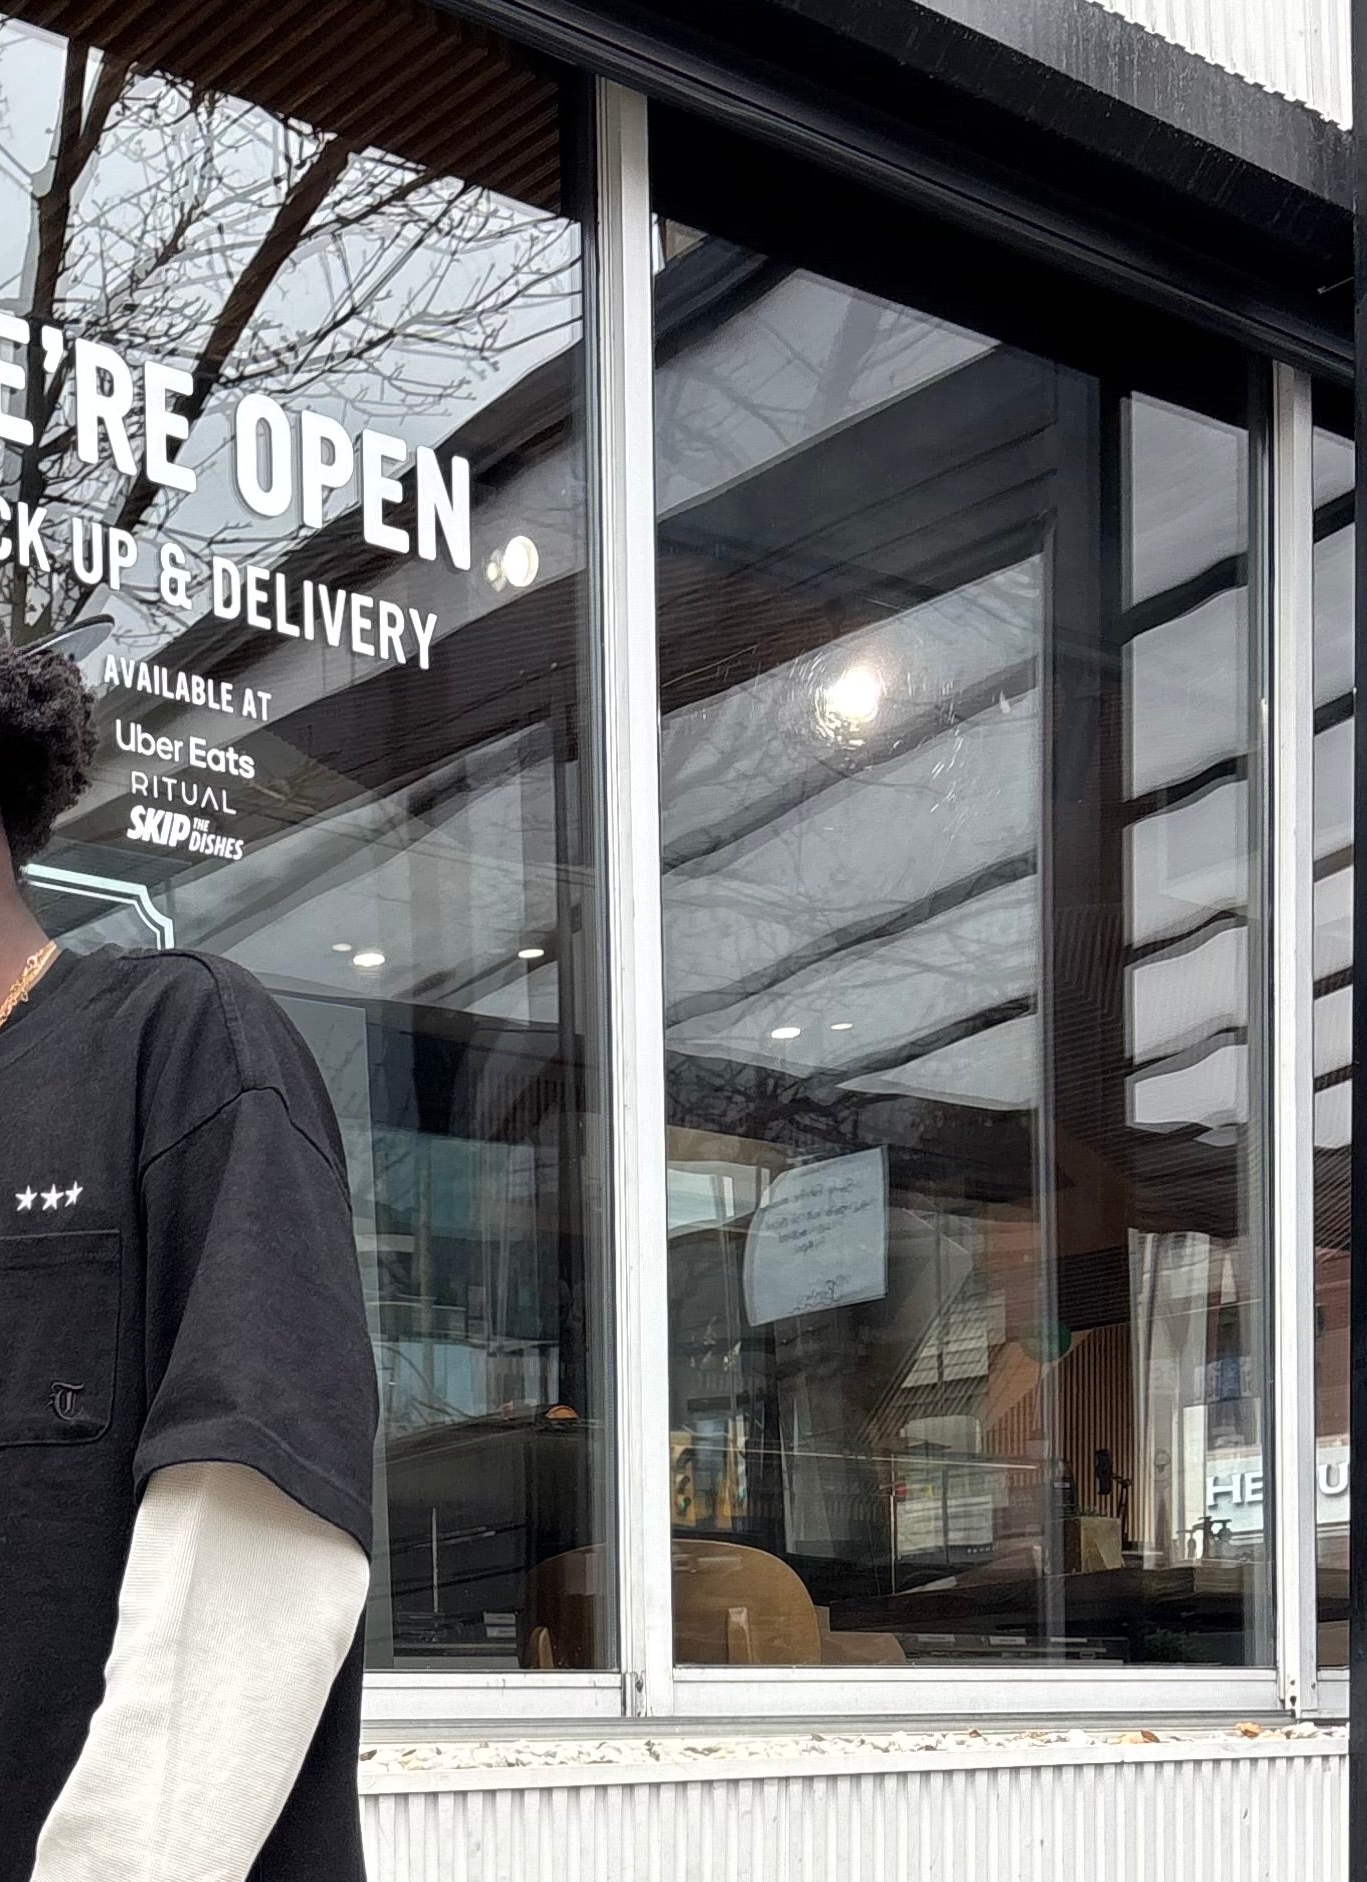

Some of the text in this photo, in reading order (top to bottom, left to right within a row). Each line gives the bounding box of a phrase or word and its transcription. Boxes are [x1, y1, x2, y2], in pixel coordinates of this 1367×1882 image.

[235, 394, 471, 571] OPEN
[72, 516, 136, 591] UP
[159, 542, 192, 610] &
[212, 554, 438, 670] DELIVERY
[104, 654, 272, 721] AVAILABLE AT
[115, 719, 255, 778] Uber Eats
[131, 771, 237, 814] RITUAL
[127, 805, 191, 847] SKIP
[189, 833, 244, 860] DISHES
[193, 817, 210, 831] THE
